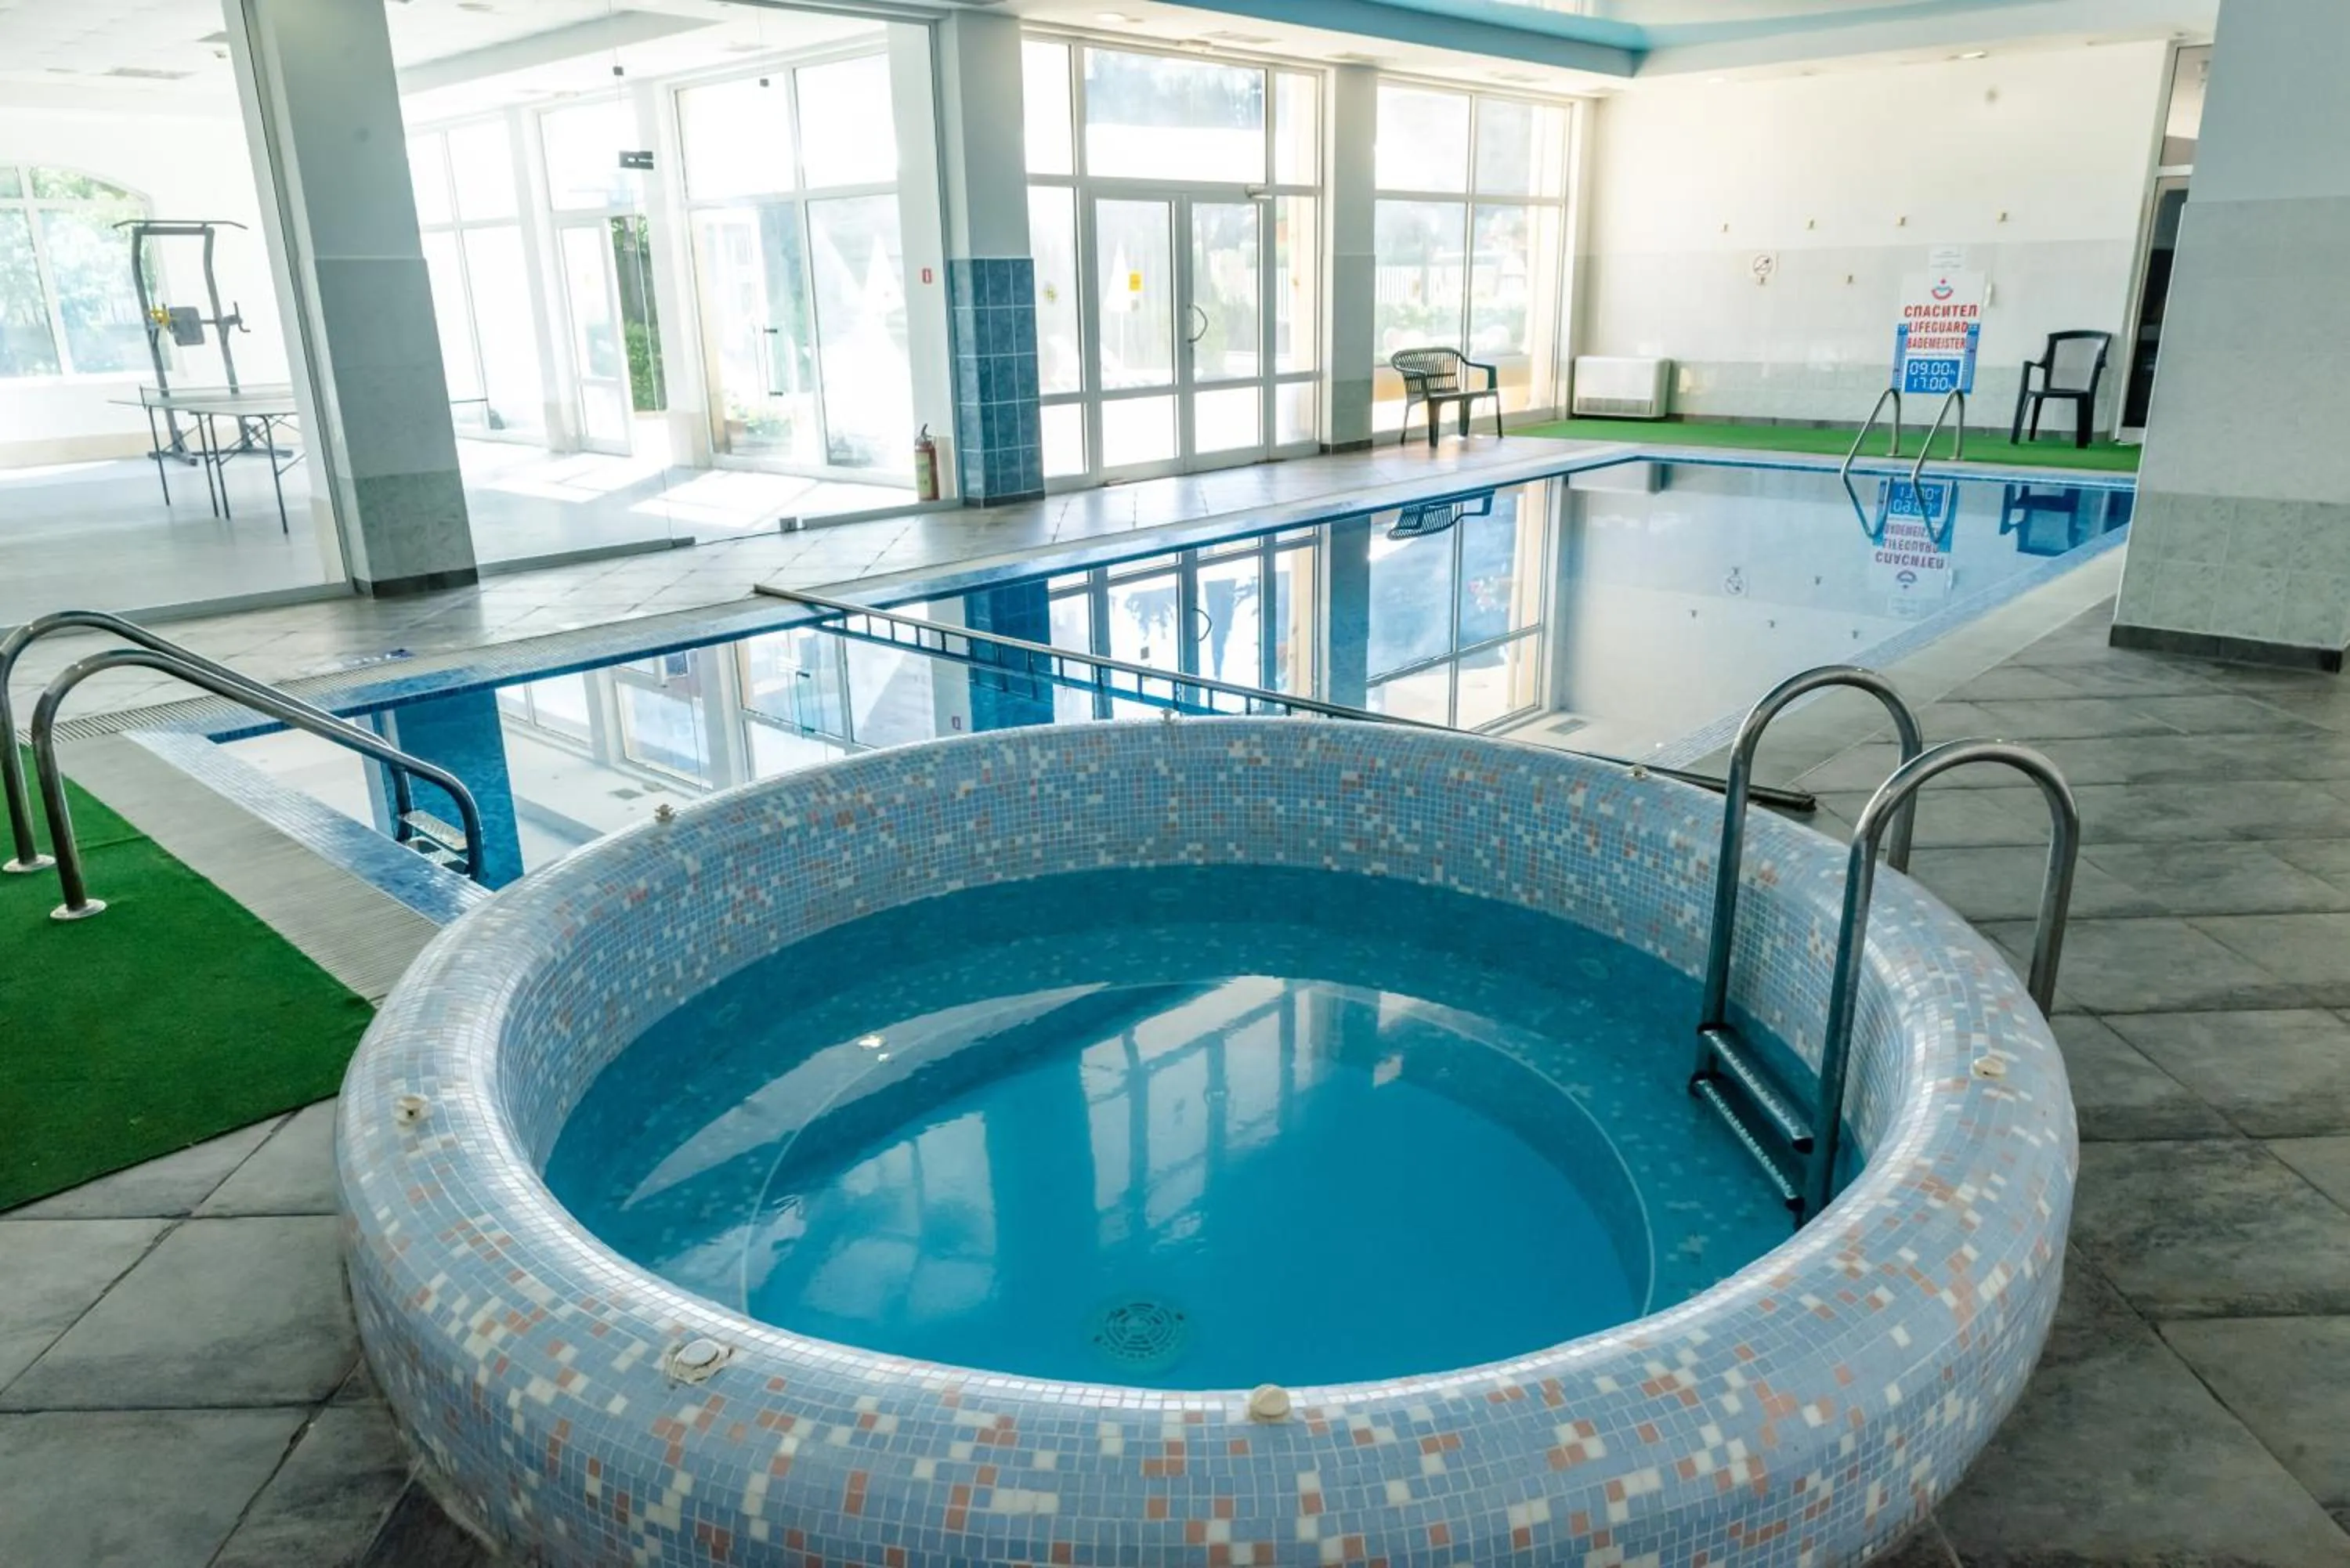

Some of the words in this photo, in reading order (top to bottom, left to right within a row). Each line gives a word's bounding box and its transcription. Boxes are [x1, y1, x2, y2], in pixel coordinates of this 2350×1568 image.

[1904, 304, 1978, 317] СПАСИТЕЛ
[1908, 320, 1969, 333] LIFEGUARD
[1907, 337, 1965, 349] BADEMEISTER
